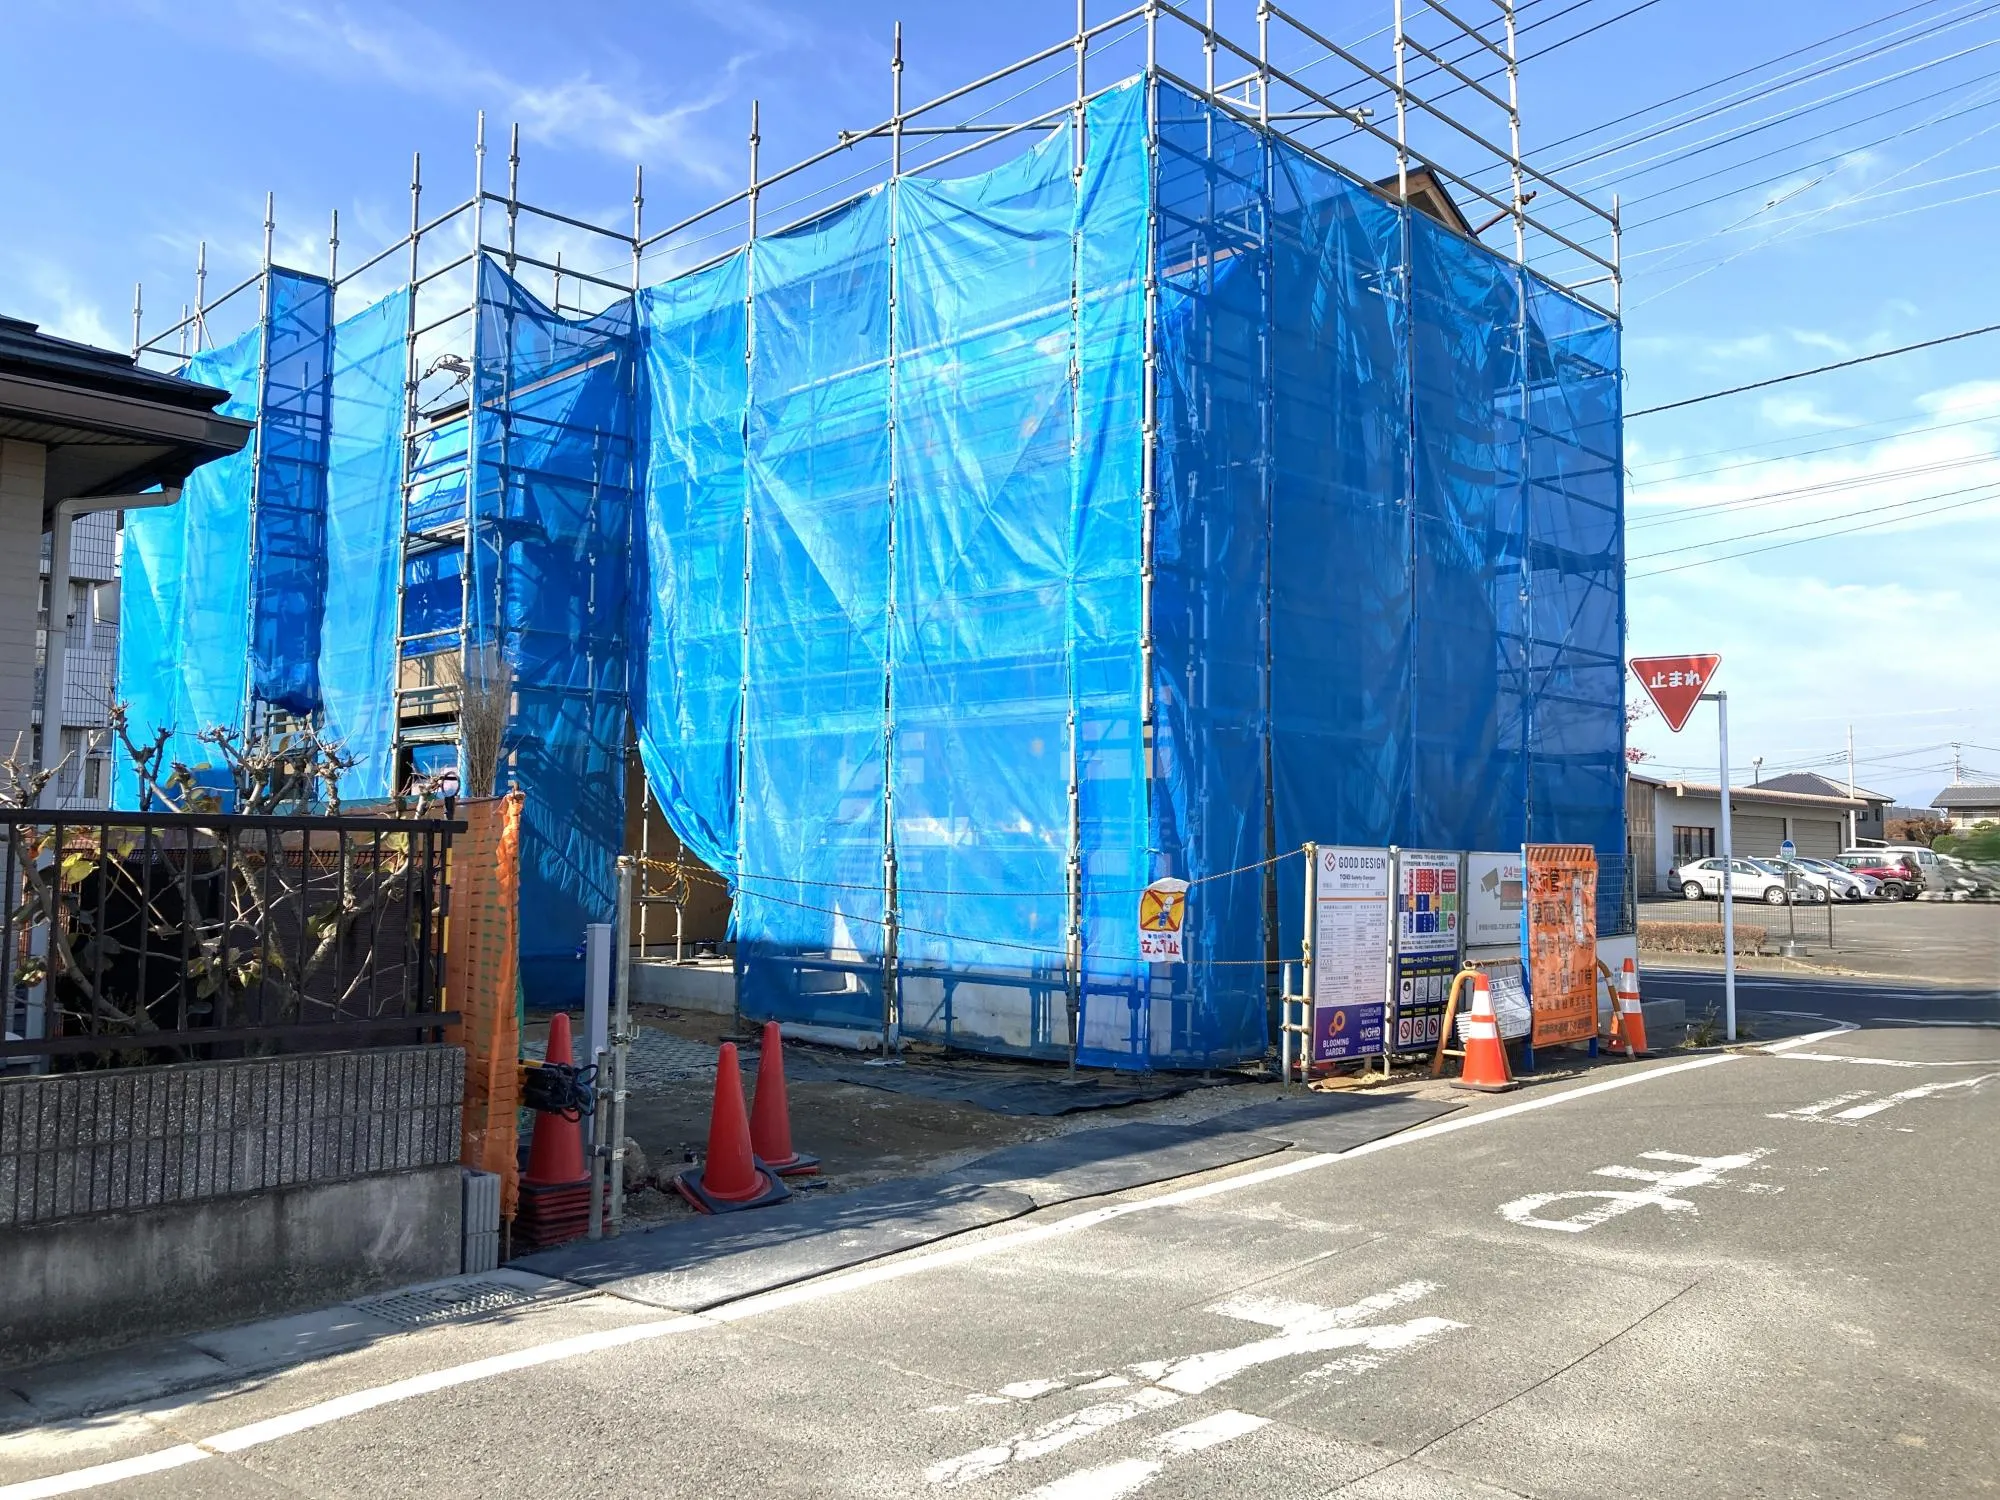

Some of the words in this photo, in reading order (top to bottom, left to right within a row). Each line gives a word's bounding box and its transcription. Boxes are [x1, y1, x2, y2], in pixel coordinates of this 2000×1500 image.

[1649, 670, 1702, 688] 止まれ
[1338, 856, 1359, 869] GOOD
[1360, 857, 1386, 869] DESIGN
[1503, 866, 1513, 878] 24
[1323, 1038, 1349, 1048] BLOOMING
[1325, 1047, 1346, 1057] GARDEN
